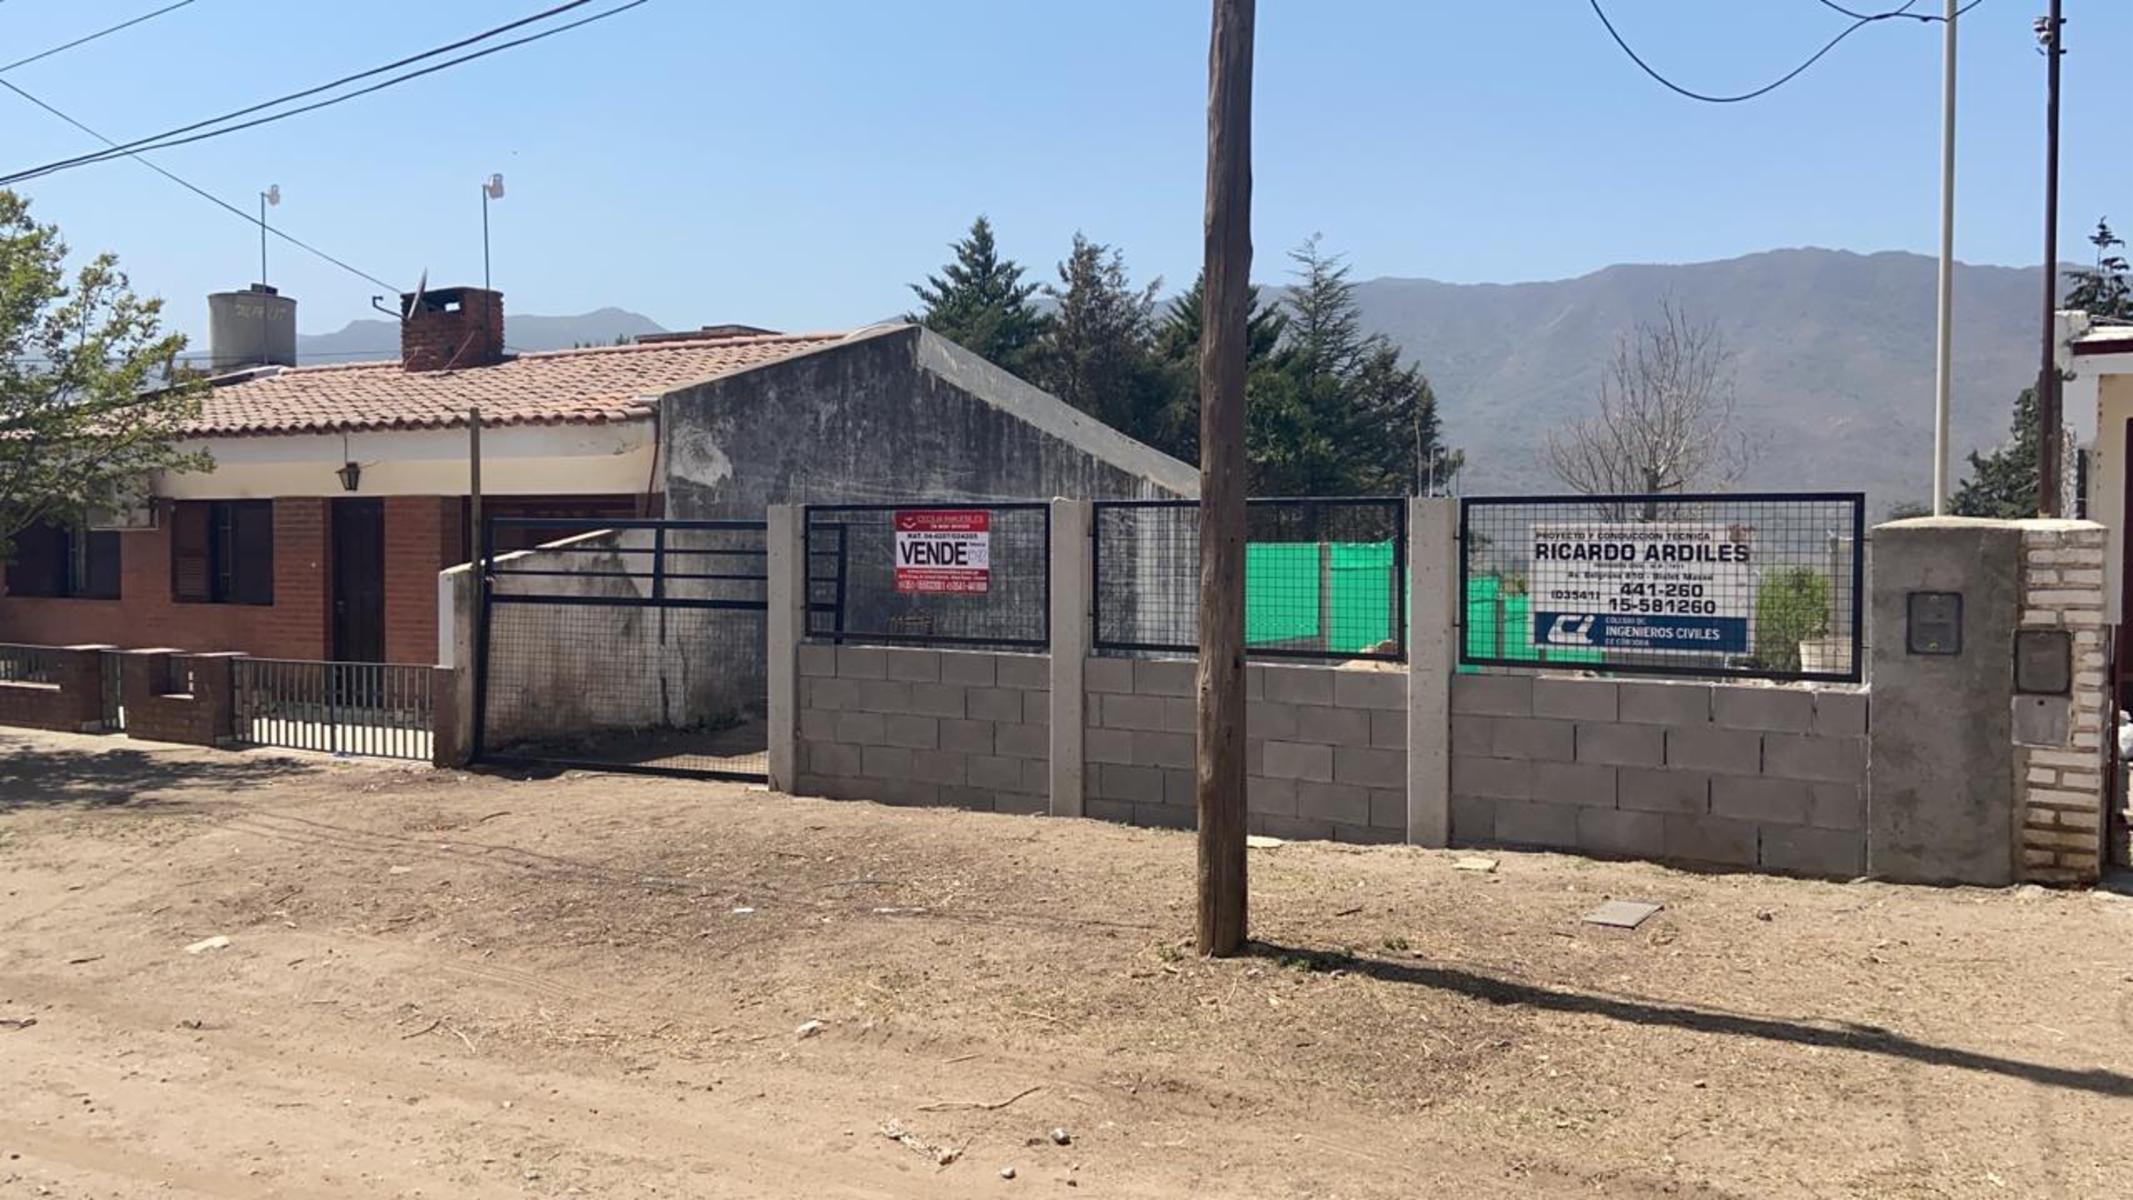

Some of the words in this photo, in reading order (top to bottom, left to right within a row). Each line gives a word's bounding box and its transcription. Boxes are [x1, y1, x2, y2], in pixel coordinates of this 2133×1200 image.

[1536, 532, 1585, 541] PROYECTO
[1588, 533, 1594, 541] Y
[900, 541, 968, 565] VENDE
[1535, 543, 1635, 561] RICARDO
[1644, 544, 1750, 562] ARDILES
[1620, 583, 1703, 598] 441-260
[1608, 598, 1716, 614] 15-581260
[1605, 625, 1674, 639] INGENIEROS
[1676, 627, 1720, 640] CIVILES
